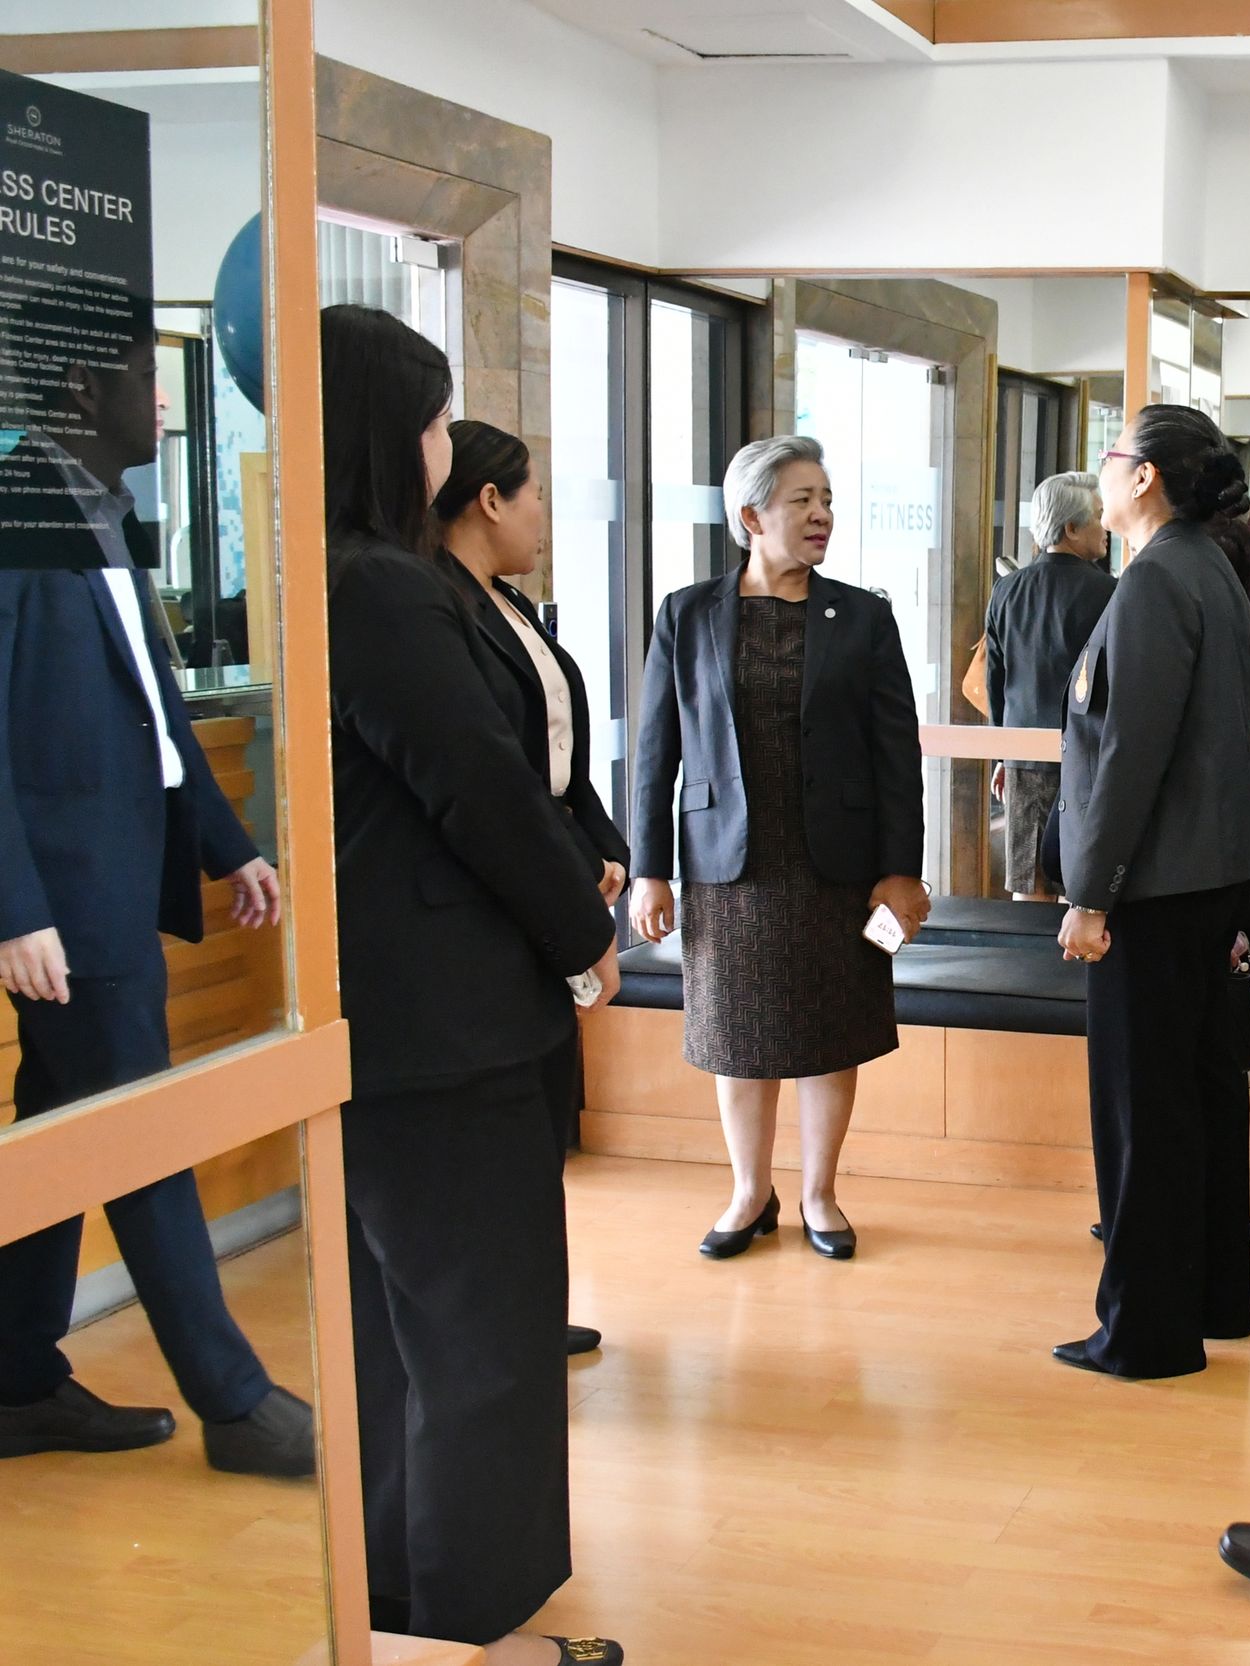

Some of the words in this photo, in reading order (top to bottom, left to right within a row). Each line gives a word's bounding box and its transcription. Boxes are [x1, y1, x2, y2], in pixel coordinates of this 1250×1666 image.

[7, 124, 62, 147] SHERATON
[0, 169, 34, 202] SS
[41, 179, 134, 224] CENTER
[0, 206, 77, 246] RULES
[16, 257, 26, 267] for
[28, 261, 44, 272] your
[46, 262, 67, 276] safety
[70, 267, 82, 277] and
[870, 501, 933, 531] FITNESS
